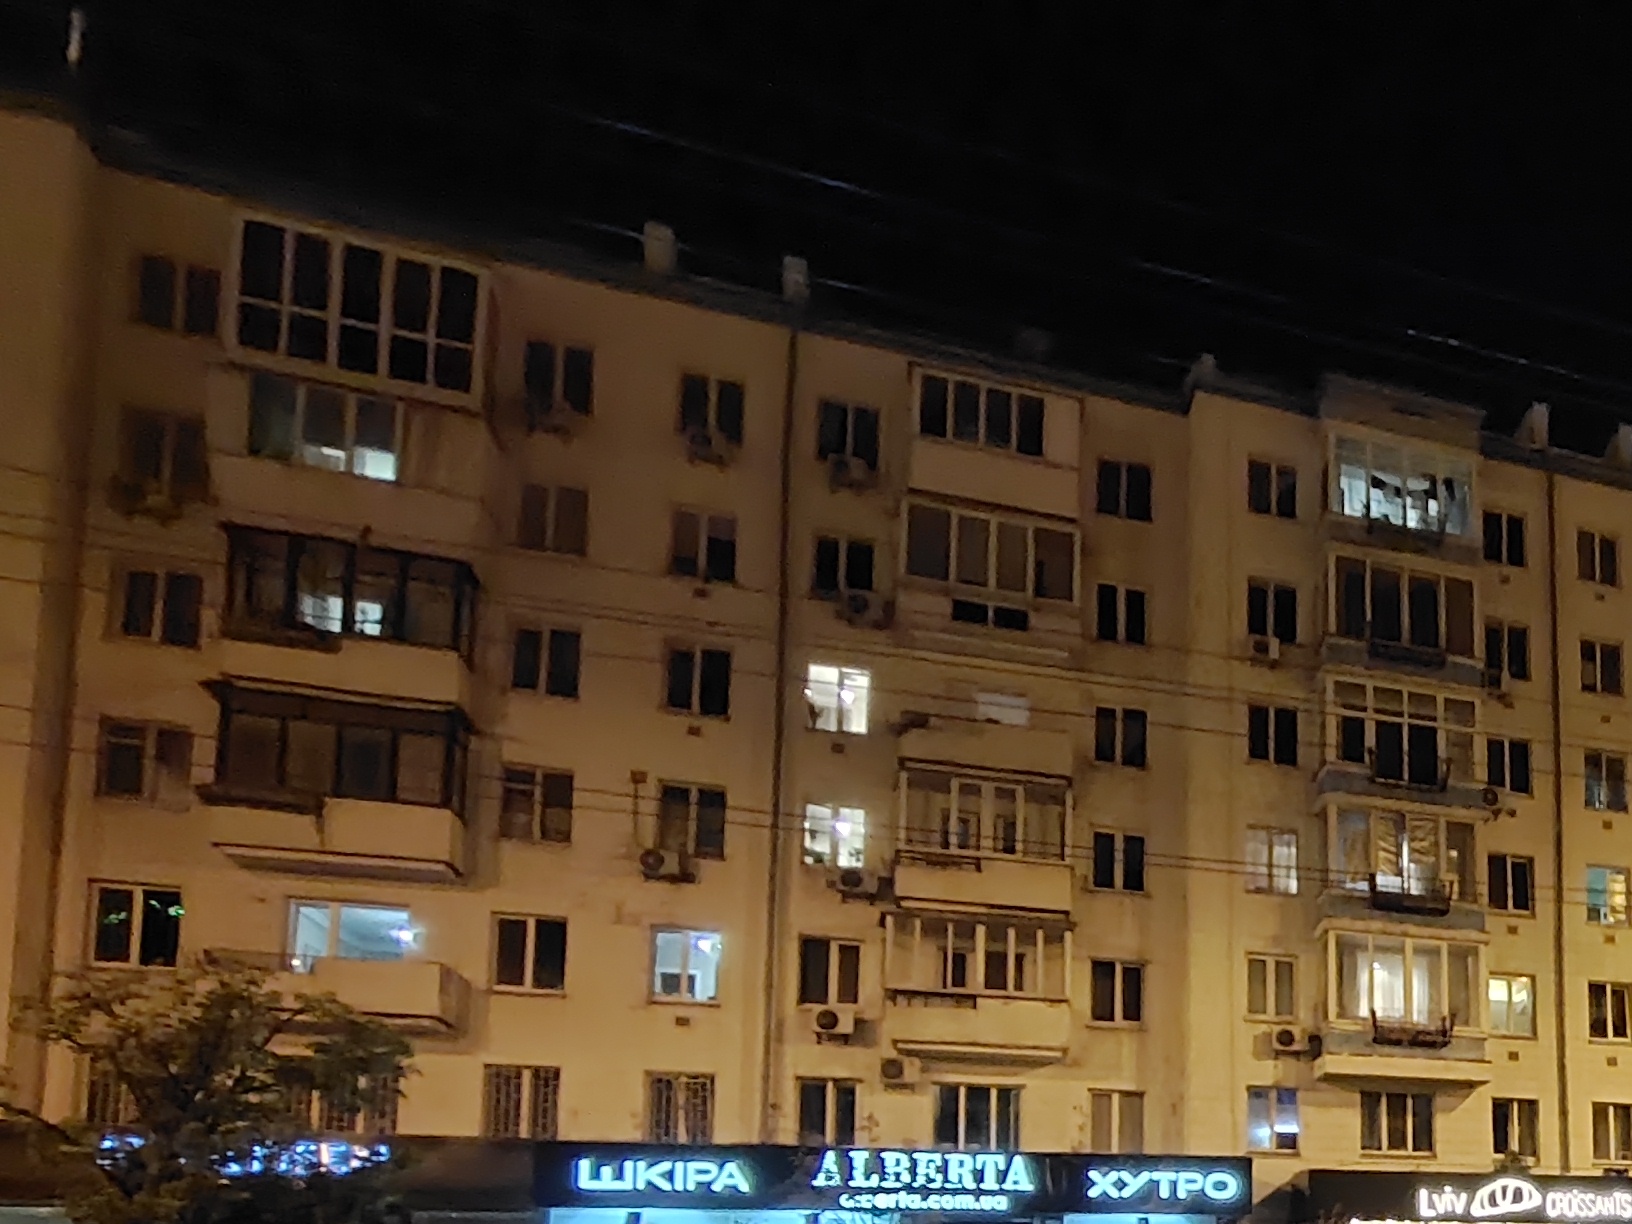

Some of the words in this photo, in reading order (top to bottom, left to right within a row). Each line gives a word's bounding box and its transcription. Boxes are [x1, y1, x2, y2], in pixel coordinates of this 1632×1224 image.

[577, 1158, 750, 1193] ШКІРА
[811, 1150, 1034, 1191] ALBERTA
[1087, 1169, 1238, 1200] ХУТРО
